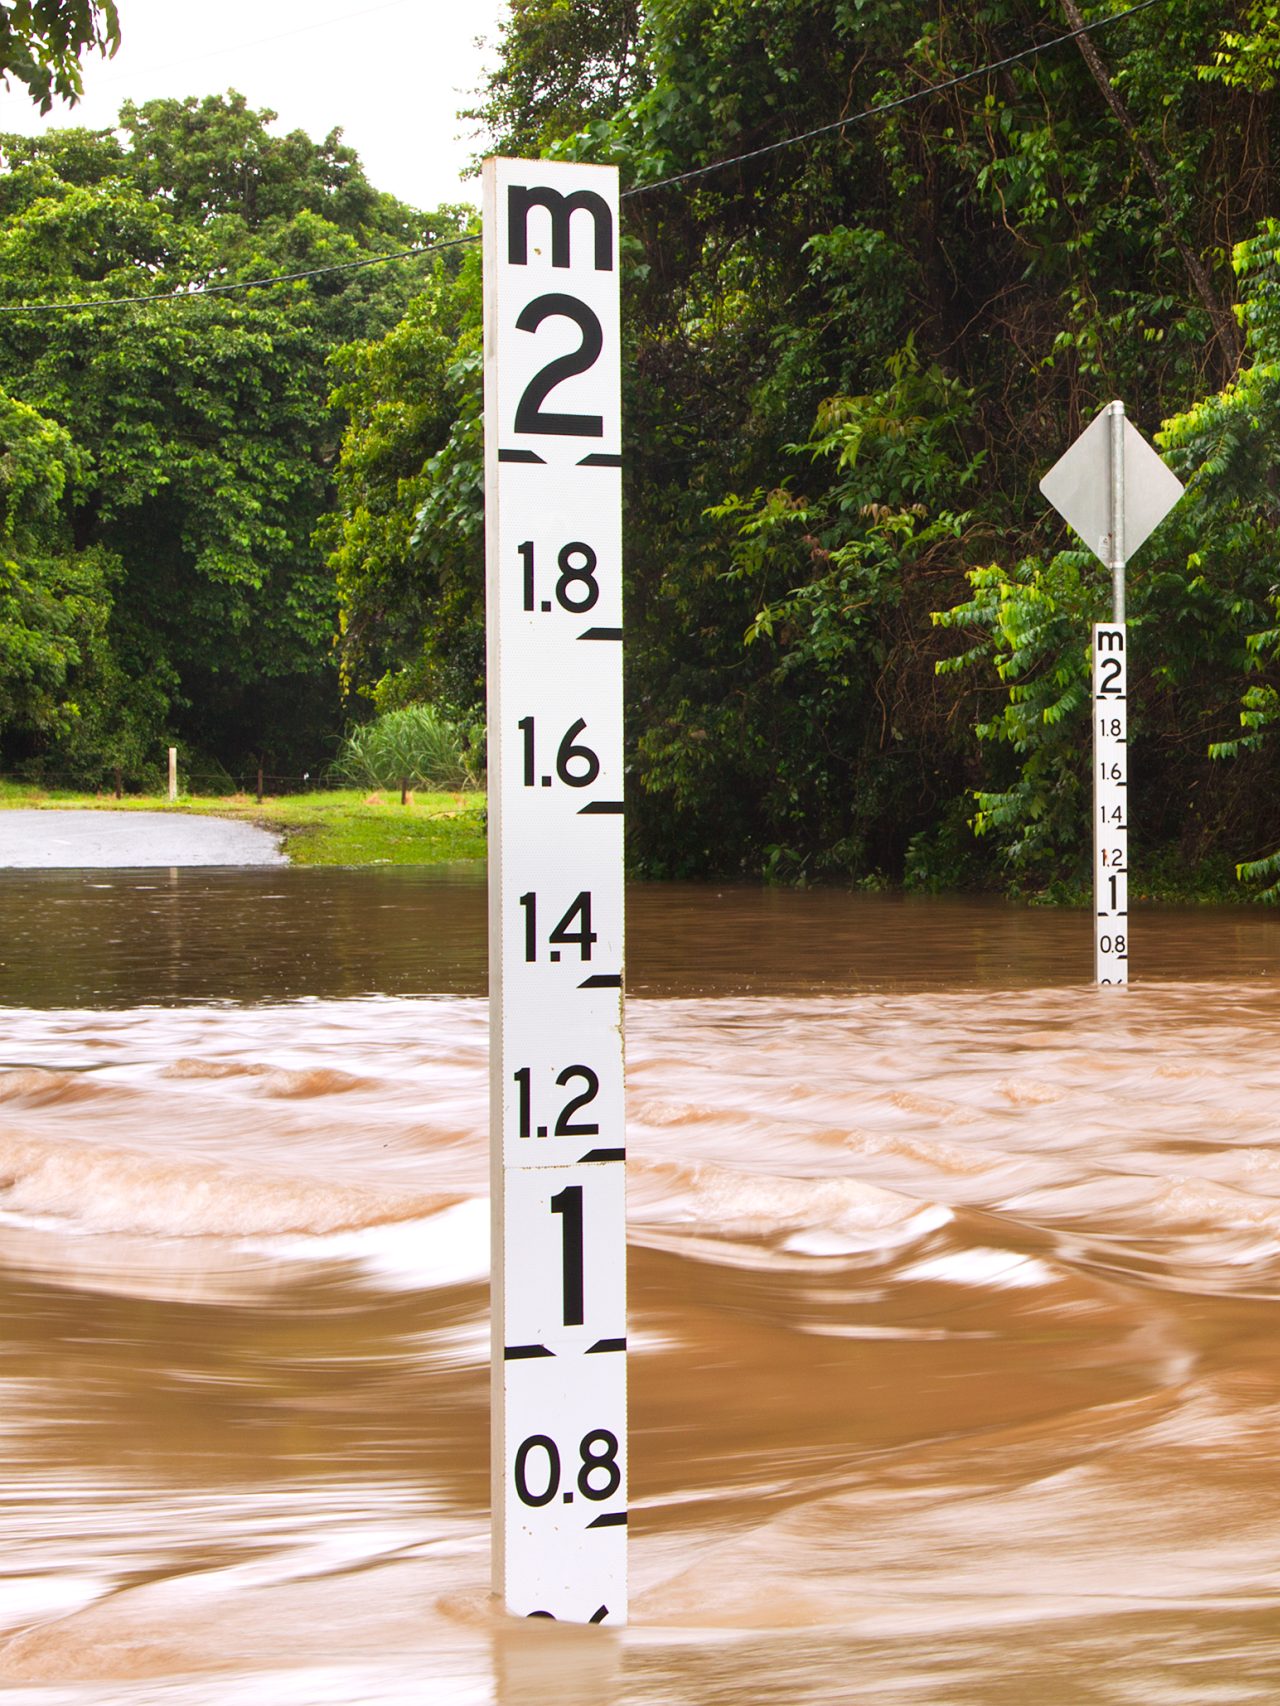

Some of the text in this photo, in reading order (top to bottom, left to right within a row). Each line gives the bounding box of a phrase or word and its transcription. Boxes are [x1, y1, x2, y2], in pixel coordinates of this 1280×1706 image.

[508, 186, 613, 272] m
[514, 293, 604, 438] 2
[517, 541, 600, 614] 1.8
[1097, 631, 1125, 652] m
[1100, 657, 1122, 694] 2
[518, 716, 600, 788] 1.6
[1100, 718, 1122, 737] 1.8
[1100, 762, 1122, 780] 1.6
[1100, 805, 1122, 824] 1.4
[1100, 848, 1123, 867] 1.2
[1108, 874, 1117, 910] 1
[519, 891, 597, 963] 1.4
[1100, 934, 1126, 954] 0.8
[514, 1064, 599, 1138] 1.2
[550, 1185, 584, 1327] 1
[514, 1428, 621, 1508] 0.8
